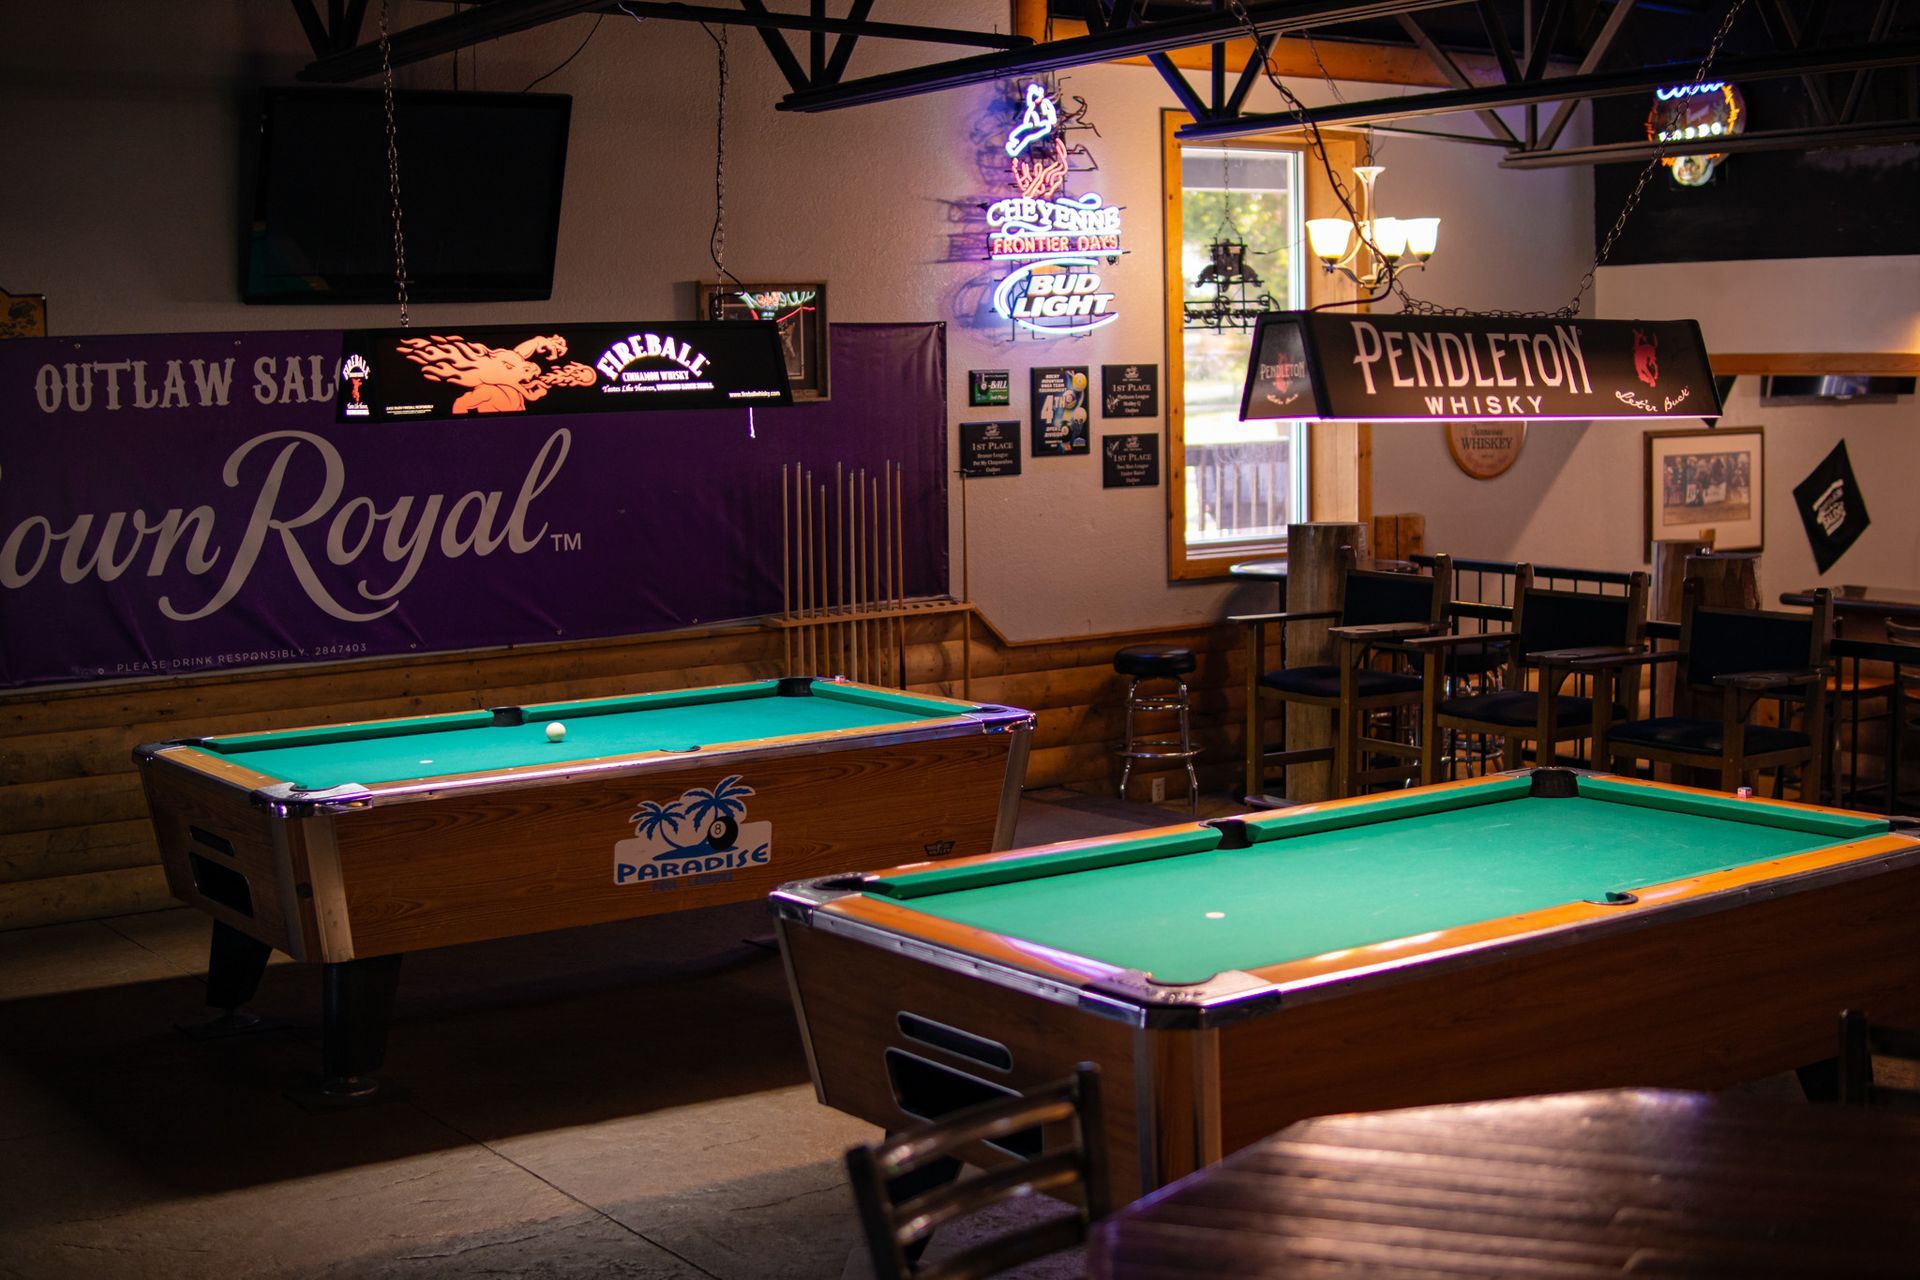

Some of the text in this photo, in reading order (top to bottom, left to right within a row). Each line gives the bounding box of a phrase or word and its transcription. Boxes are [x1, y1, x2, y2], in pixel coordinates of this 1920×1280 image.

[986, 198, 1121, 231] CHEYENNE
[993, 234, 1118, 254] FRONTIER DAYS
[1027, 274, 1101, 296] BUD
[1012, 293, 1115, 318] LIGHT
[343, 354, 371, 380] FIREBALL
[596, 333, 708, 382] FIREBALL
[1350, 321, 1593, 395] PENDLETON
[622, 370, 690, 382] CINNAMON WHISKY
[1260, 361, 1305, 380] PENDLETON
[34, 358, 236, 413] OUTLAW
[1112, 383, 1151, 392] 1ST PLACE
[1041, 395, 1066, 424] 4TH
[1424, 395, 1543, 415] WHISKY
[1615, 388, 1690, 413] Let'er Buck
[972, 442, 1013, 451] 1ST PLACE
[1461, 437, 1513, 450] WHISKEY
[1113, 453, 1152, 462] 1ST PLACE
[0, 427, 581, 622] own Royal TM
[117, 659, 167, 673] PLEASE
[172, 655, 212, 669] DRINK
[315, 642, 367, 656] 2847403
[714, 823, 721, 835] 8
[617, 843, 769, 883] PARADISE
